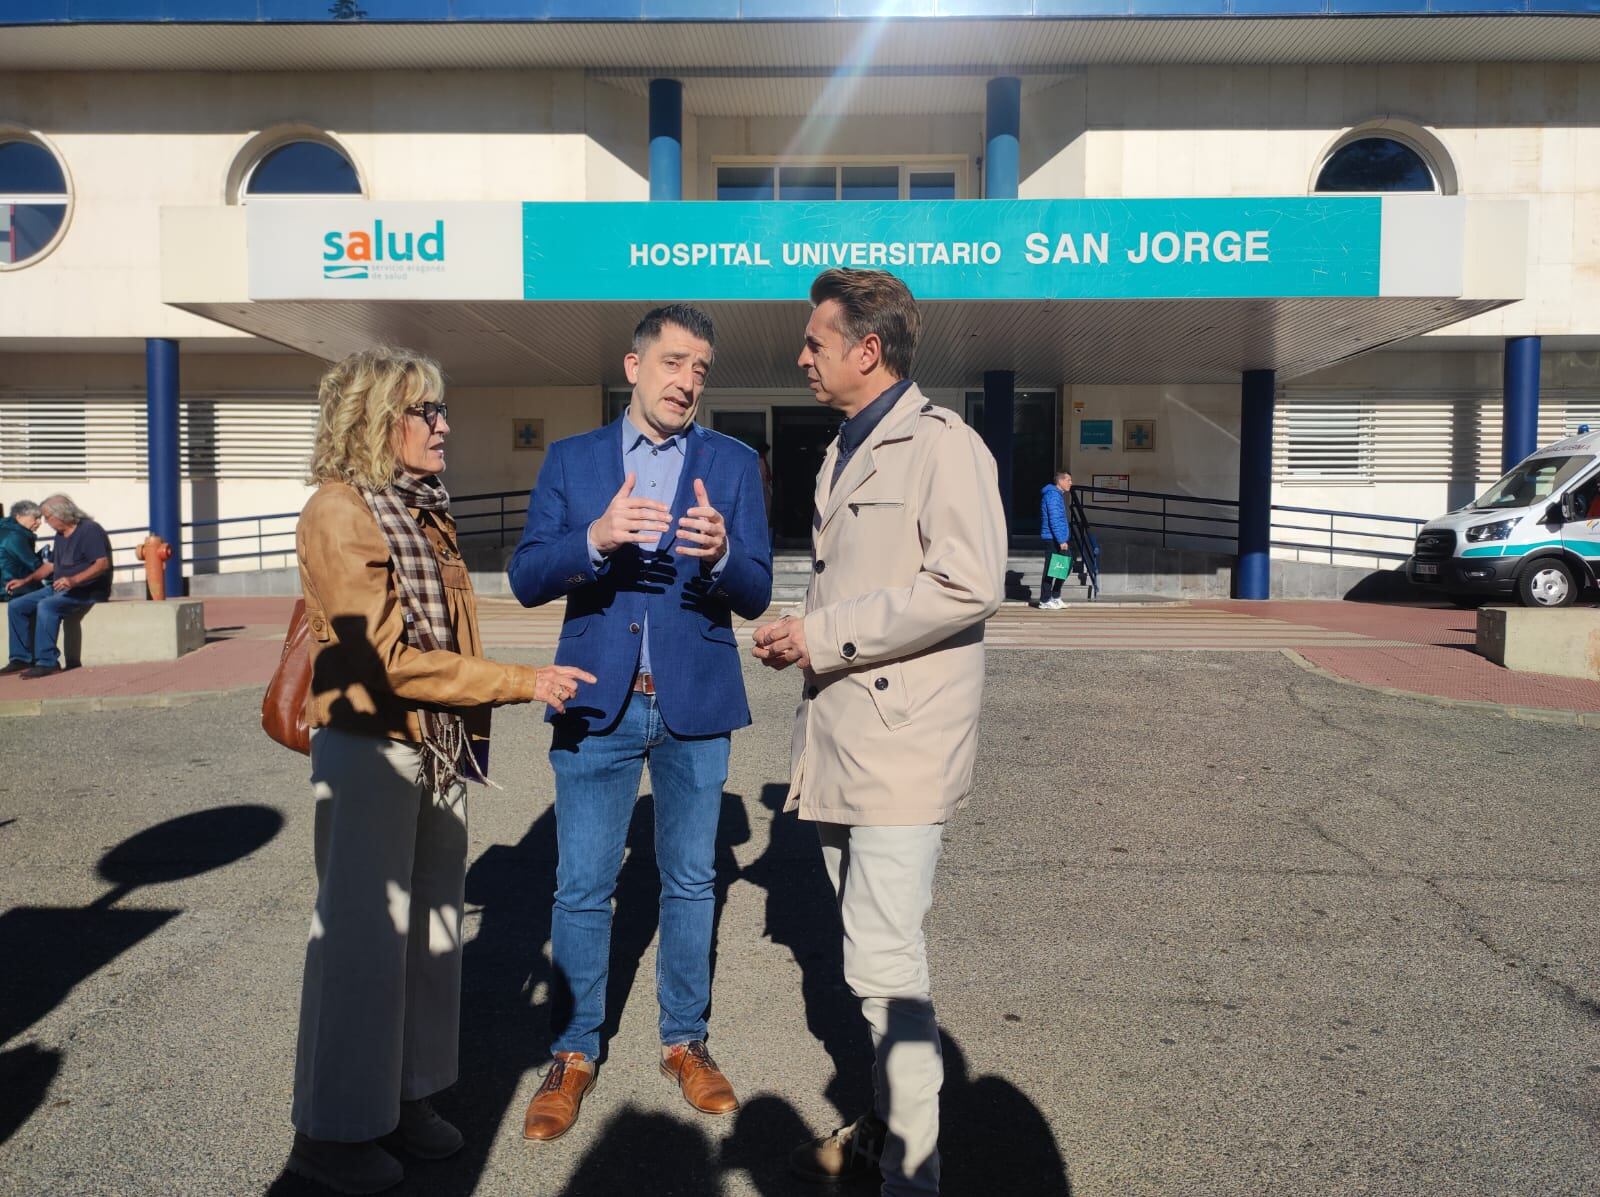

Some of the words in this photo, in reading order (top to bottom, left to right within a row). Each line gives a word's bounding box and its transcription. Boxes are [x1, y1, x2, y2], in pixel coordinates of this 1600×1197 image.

[323, 219, 444, 262] salud
[630, 243, 770, 266] HOSPITAL
[783, 242, 1002, 265] UNIVERSITARIO
[1025, 232, 1109, 264] SAN
[1127, 230, 1269, 264] JORGE
